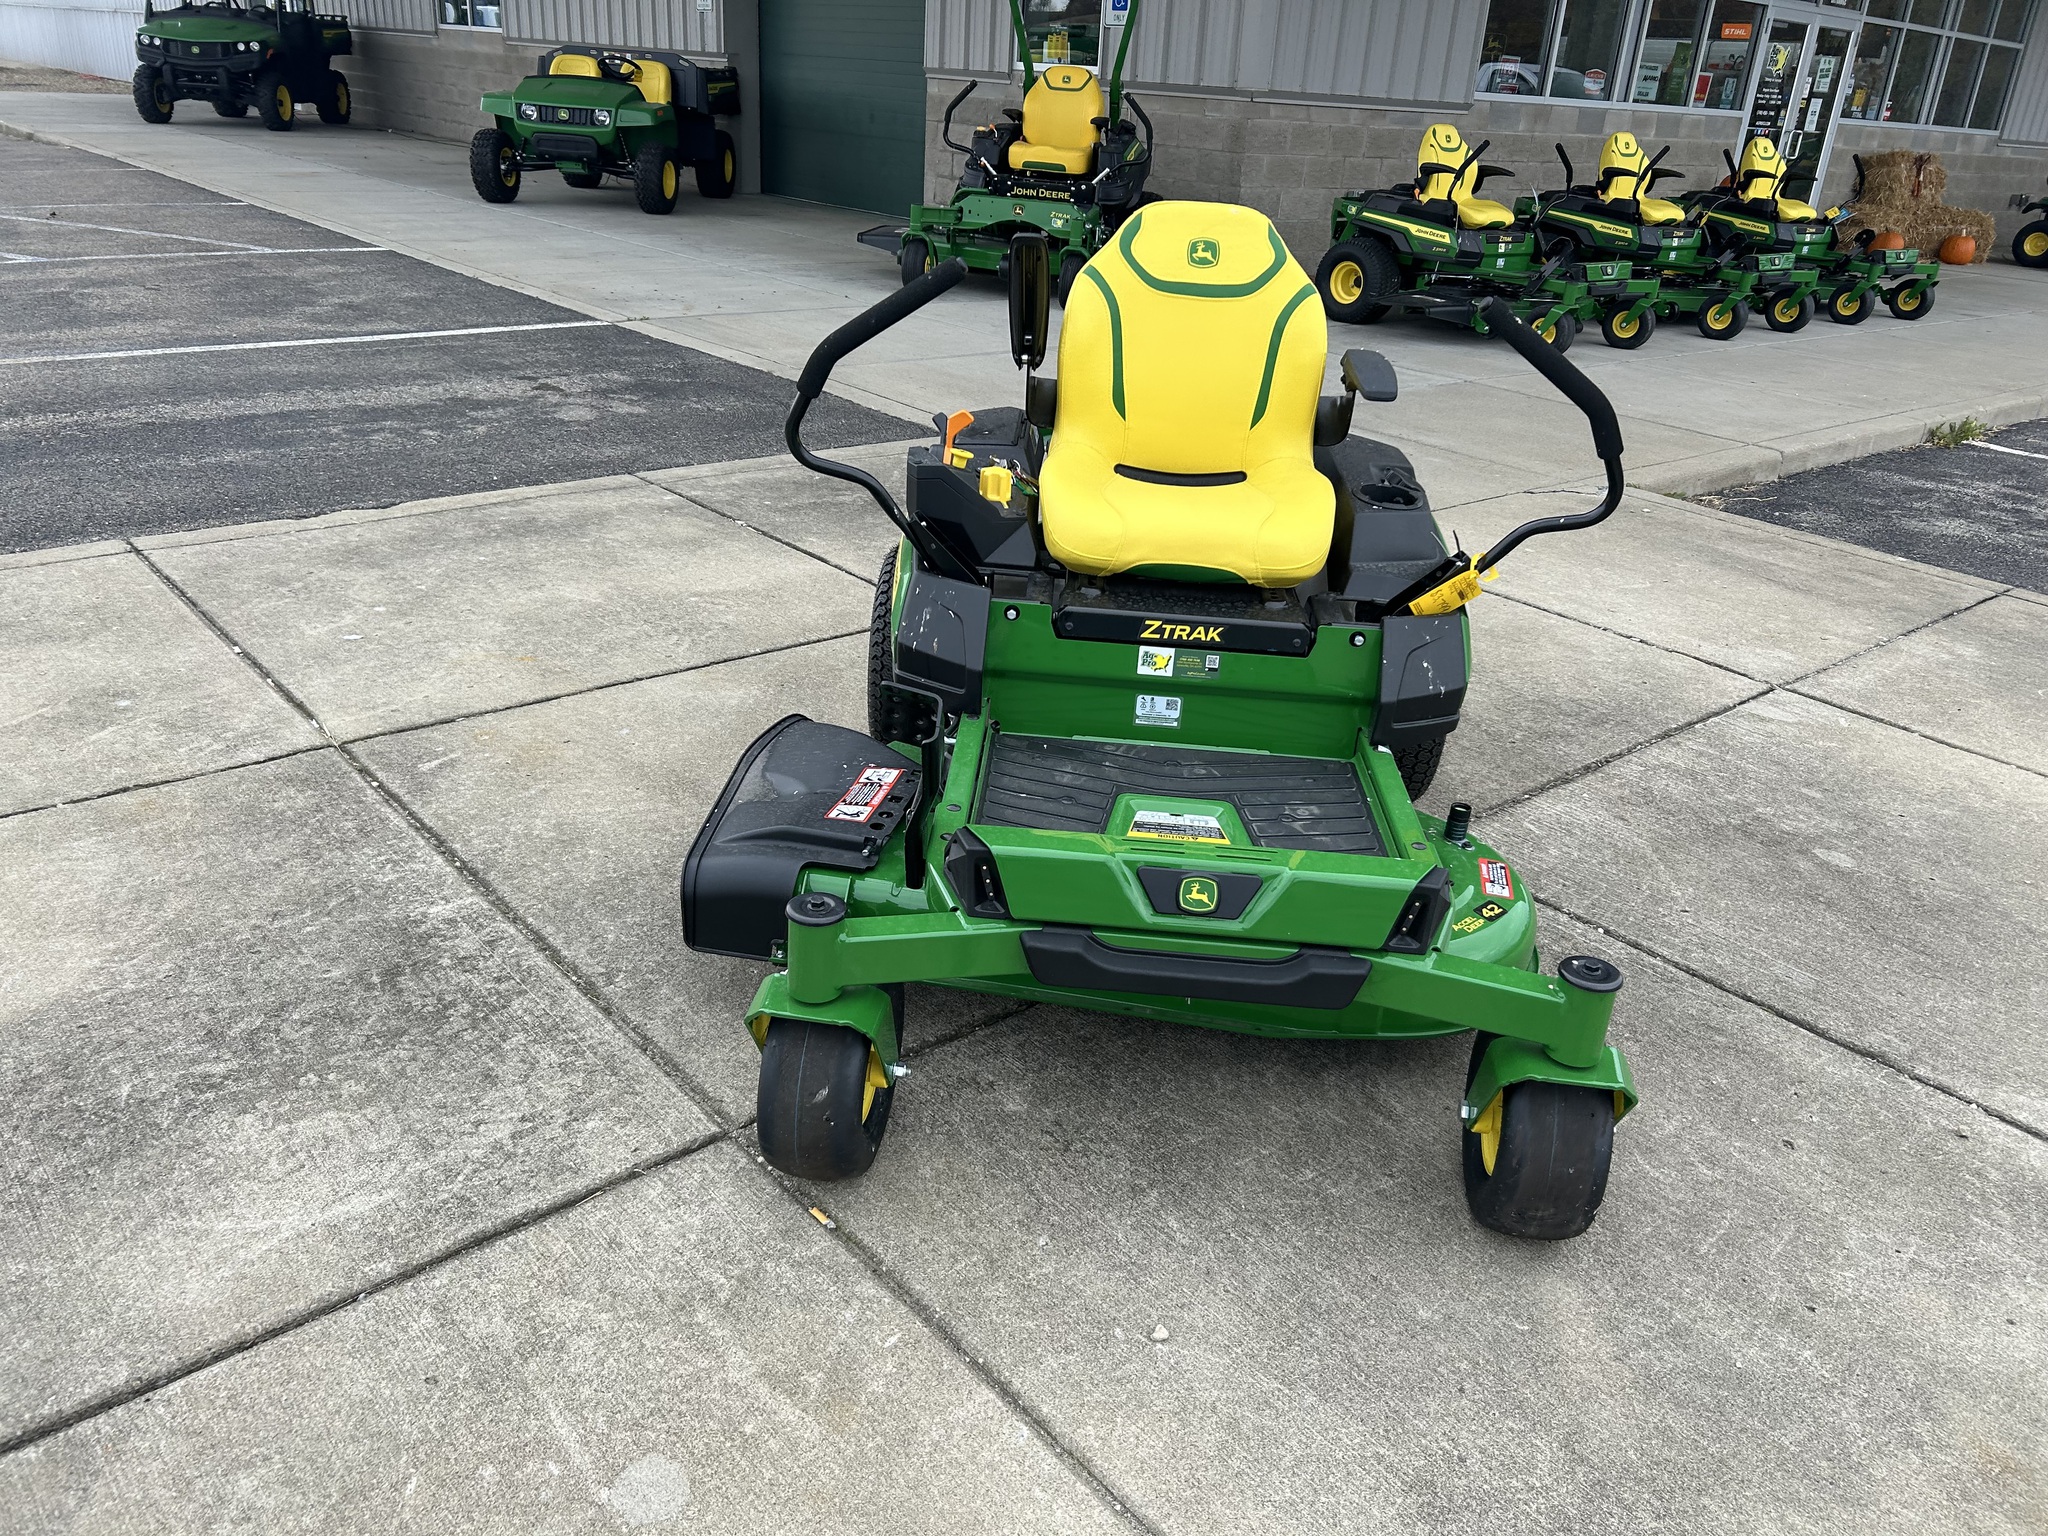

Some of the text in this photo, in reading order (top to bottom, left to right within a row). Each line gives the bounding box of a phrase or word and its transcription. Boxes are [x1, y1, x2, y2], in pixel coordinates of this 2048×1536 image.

[1113, 14, 1125, 22] ONLY
[1011, 186, 1071, 200] JOHN DEERE
[1050, 211, 1071, 219] ZTRAK
[1612, 227, 1628, 235] DEERE
[1751, 223, 1767, 231] DEERE
[1429, 231, 1447, 240] DEERE
[1140, 620, 1224, 642] ZTRAK
[1141, 659, 1157, 667] Pro
[1482, 904, 1504, 918] 42
[1452, 916, 1477, 931] ACCEL
[1464, 918, 1485, 933] DEEP
